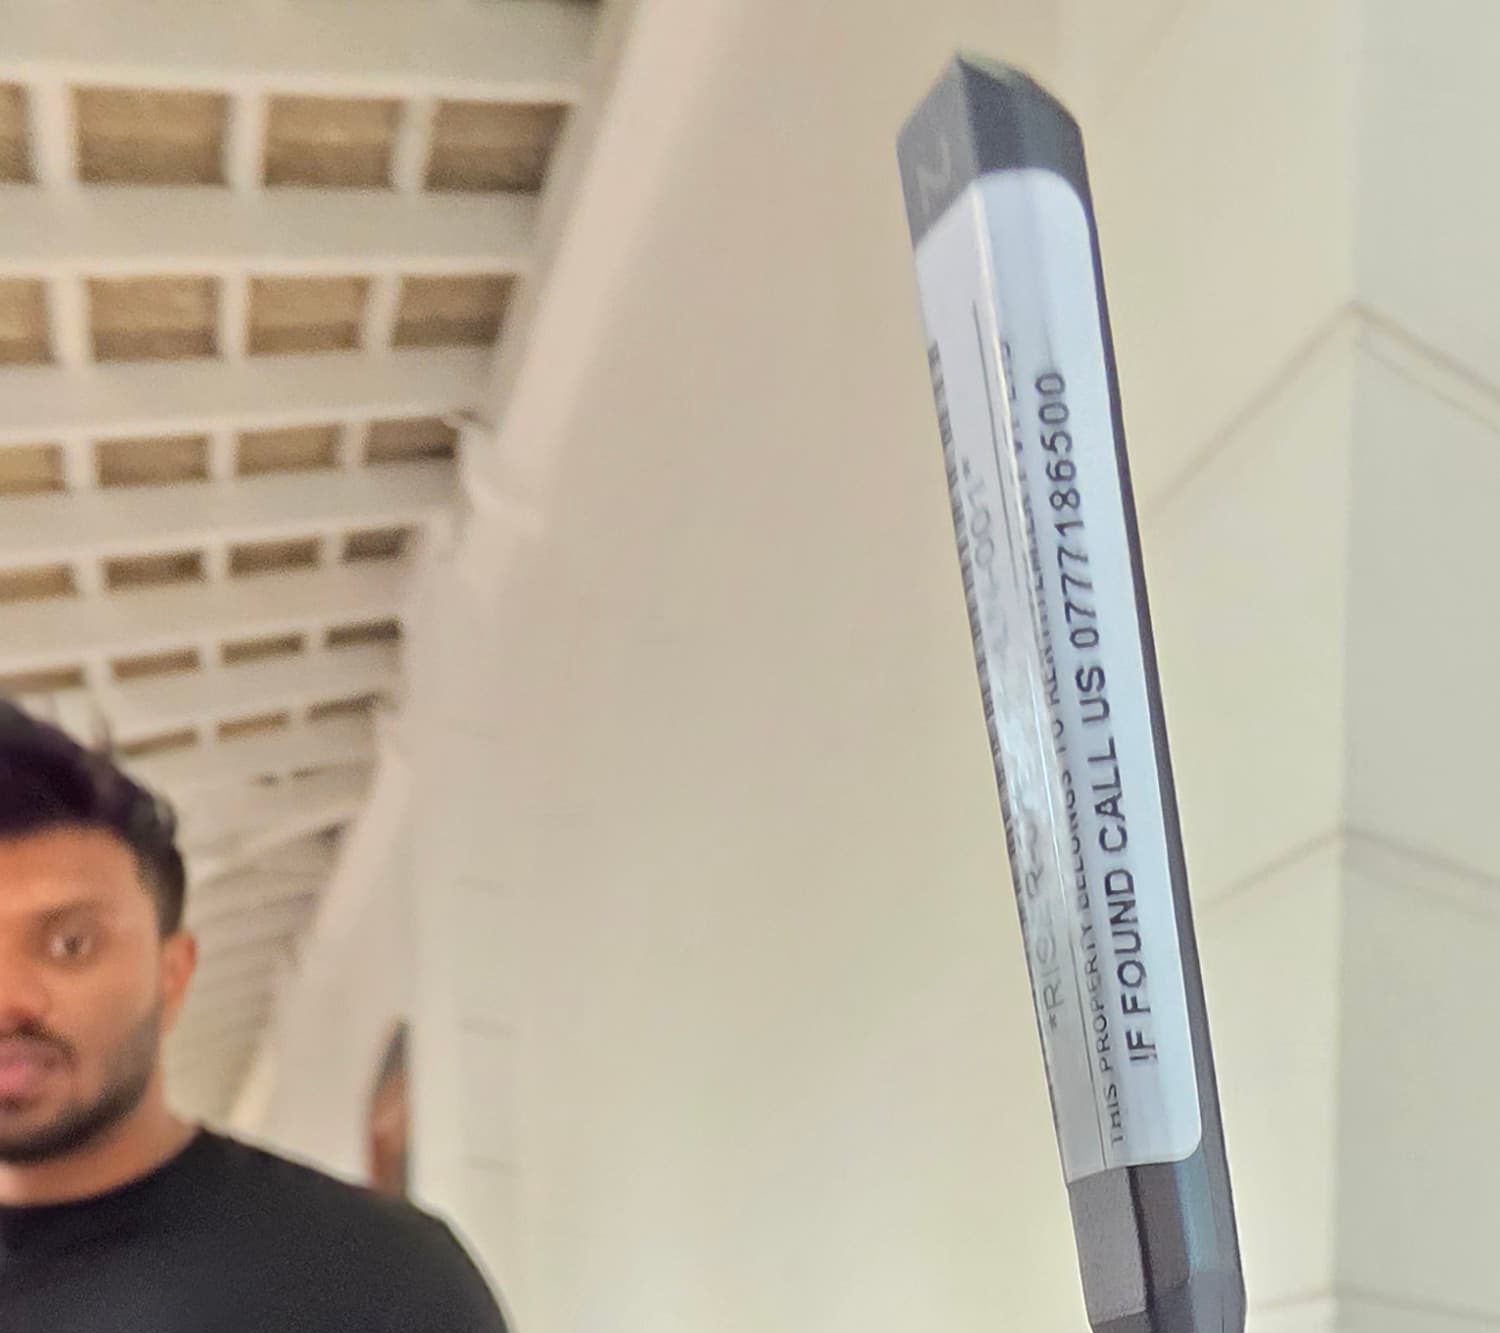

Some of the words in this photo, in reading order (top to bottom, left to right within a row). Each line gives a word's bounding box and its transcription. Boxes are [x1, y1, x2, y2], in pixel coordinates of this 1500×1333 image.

[1035, 372, 1100, 649] 0777186500
[1075, 665, 1111, 724] US
[1088, 736, 1129, 854] CALL
[1080, 924, 1114, 1074] PROPERTY
[1104, 868, 1152, 1016] FOUND
[1125, 1030, 1158, 1066] IF
[1104, 1083, 1124, 1145] THIS
